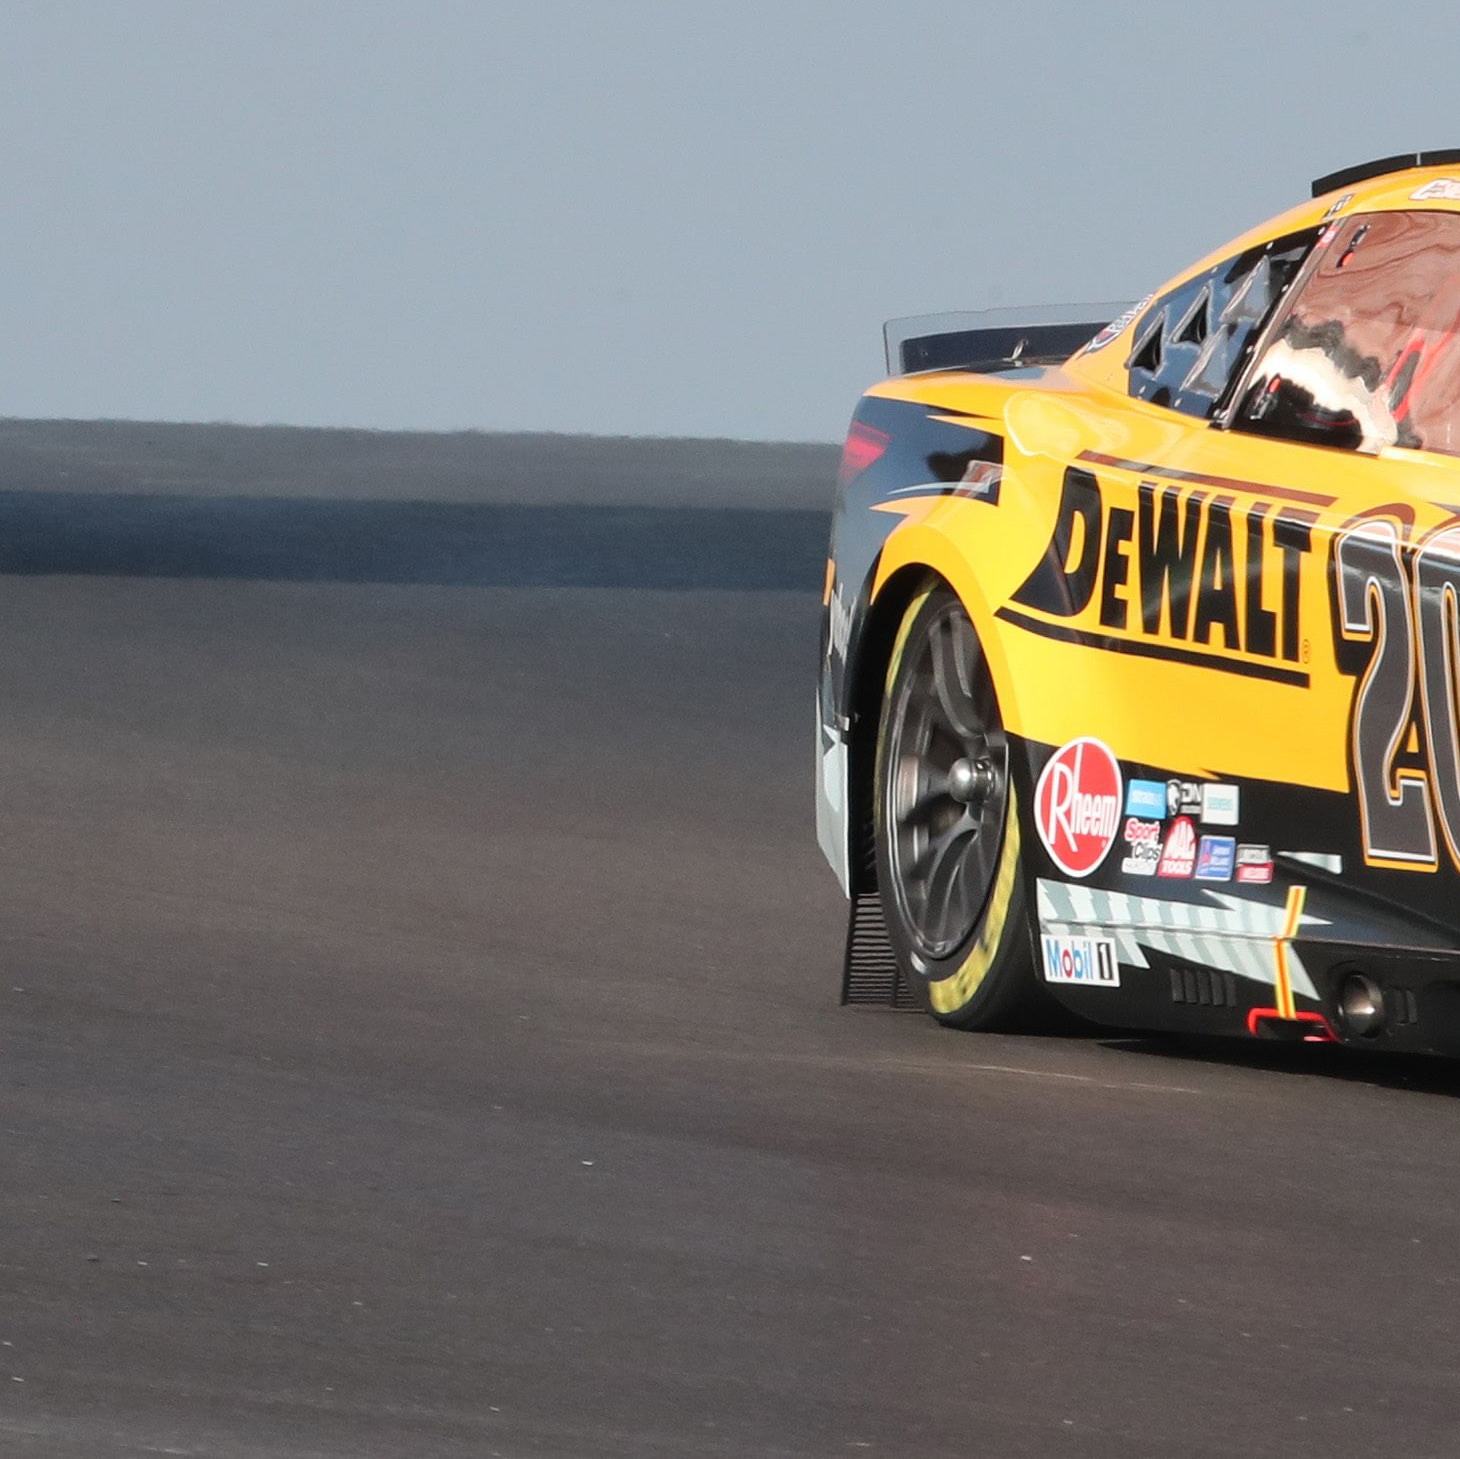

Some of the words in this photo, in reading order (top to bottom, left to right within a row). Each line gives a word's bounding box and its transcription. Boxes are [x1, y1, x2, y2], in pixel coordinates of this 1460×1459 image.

[1047, 742, 1117, 853] Rheem
[1125, 818, 1160, 845] Sport
[1134, 842, 1163, 862] Clips
[1161, 859, 1194, 874] TOOLS
[1045, 939, 1094, 980] Mobil
[1098, 943, 1112, 980] 1
